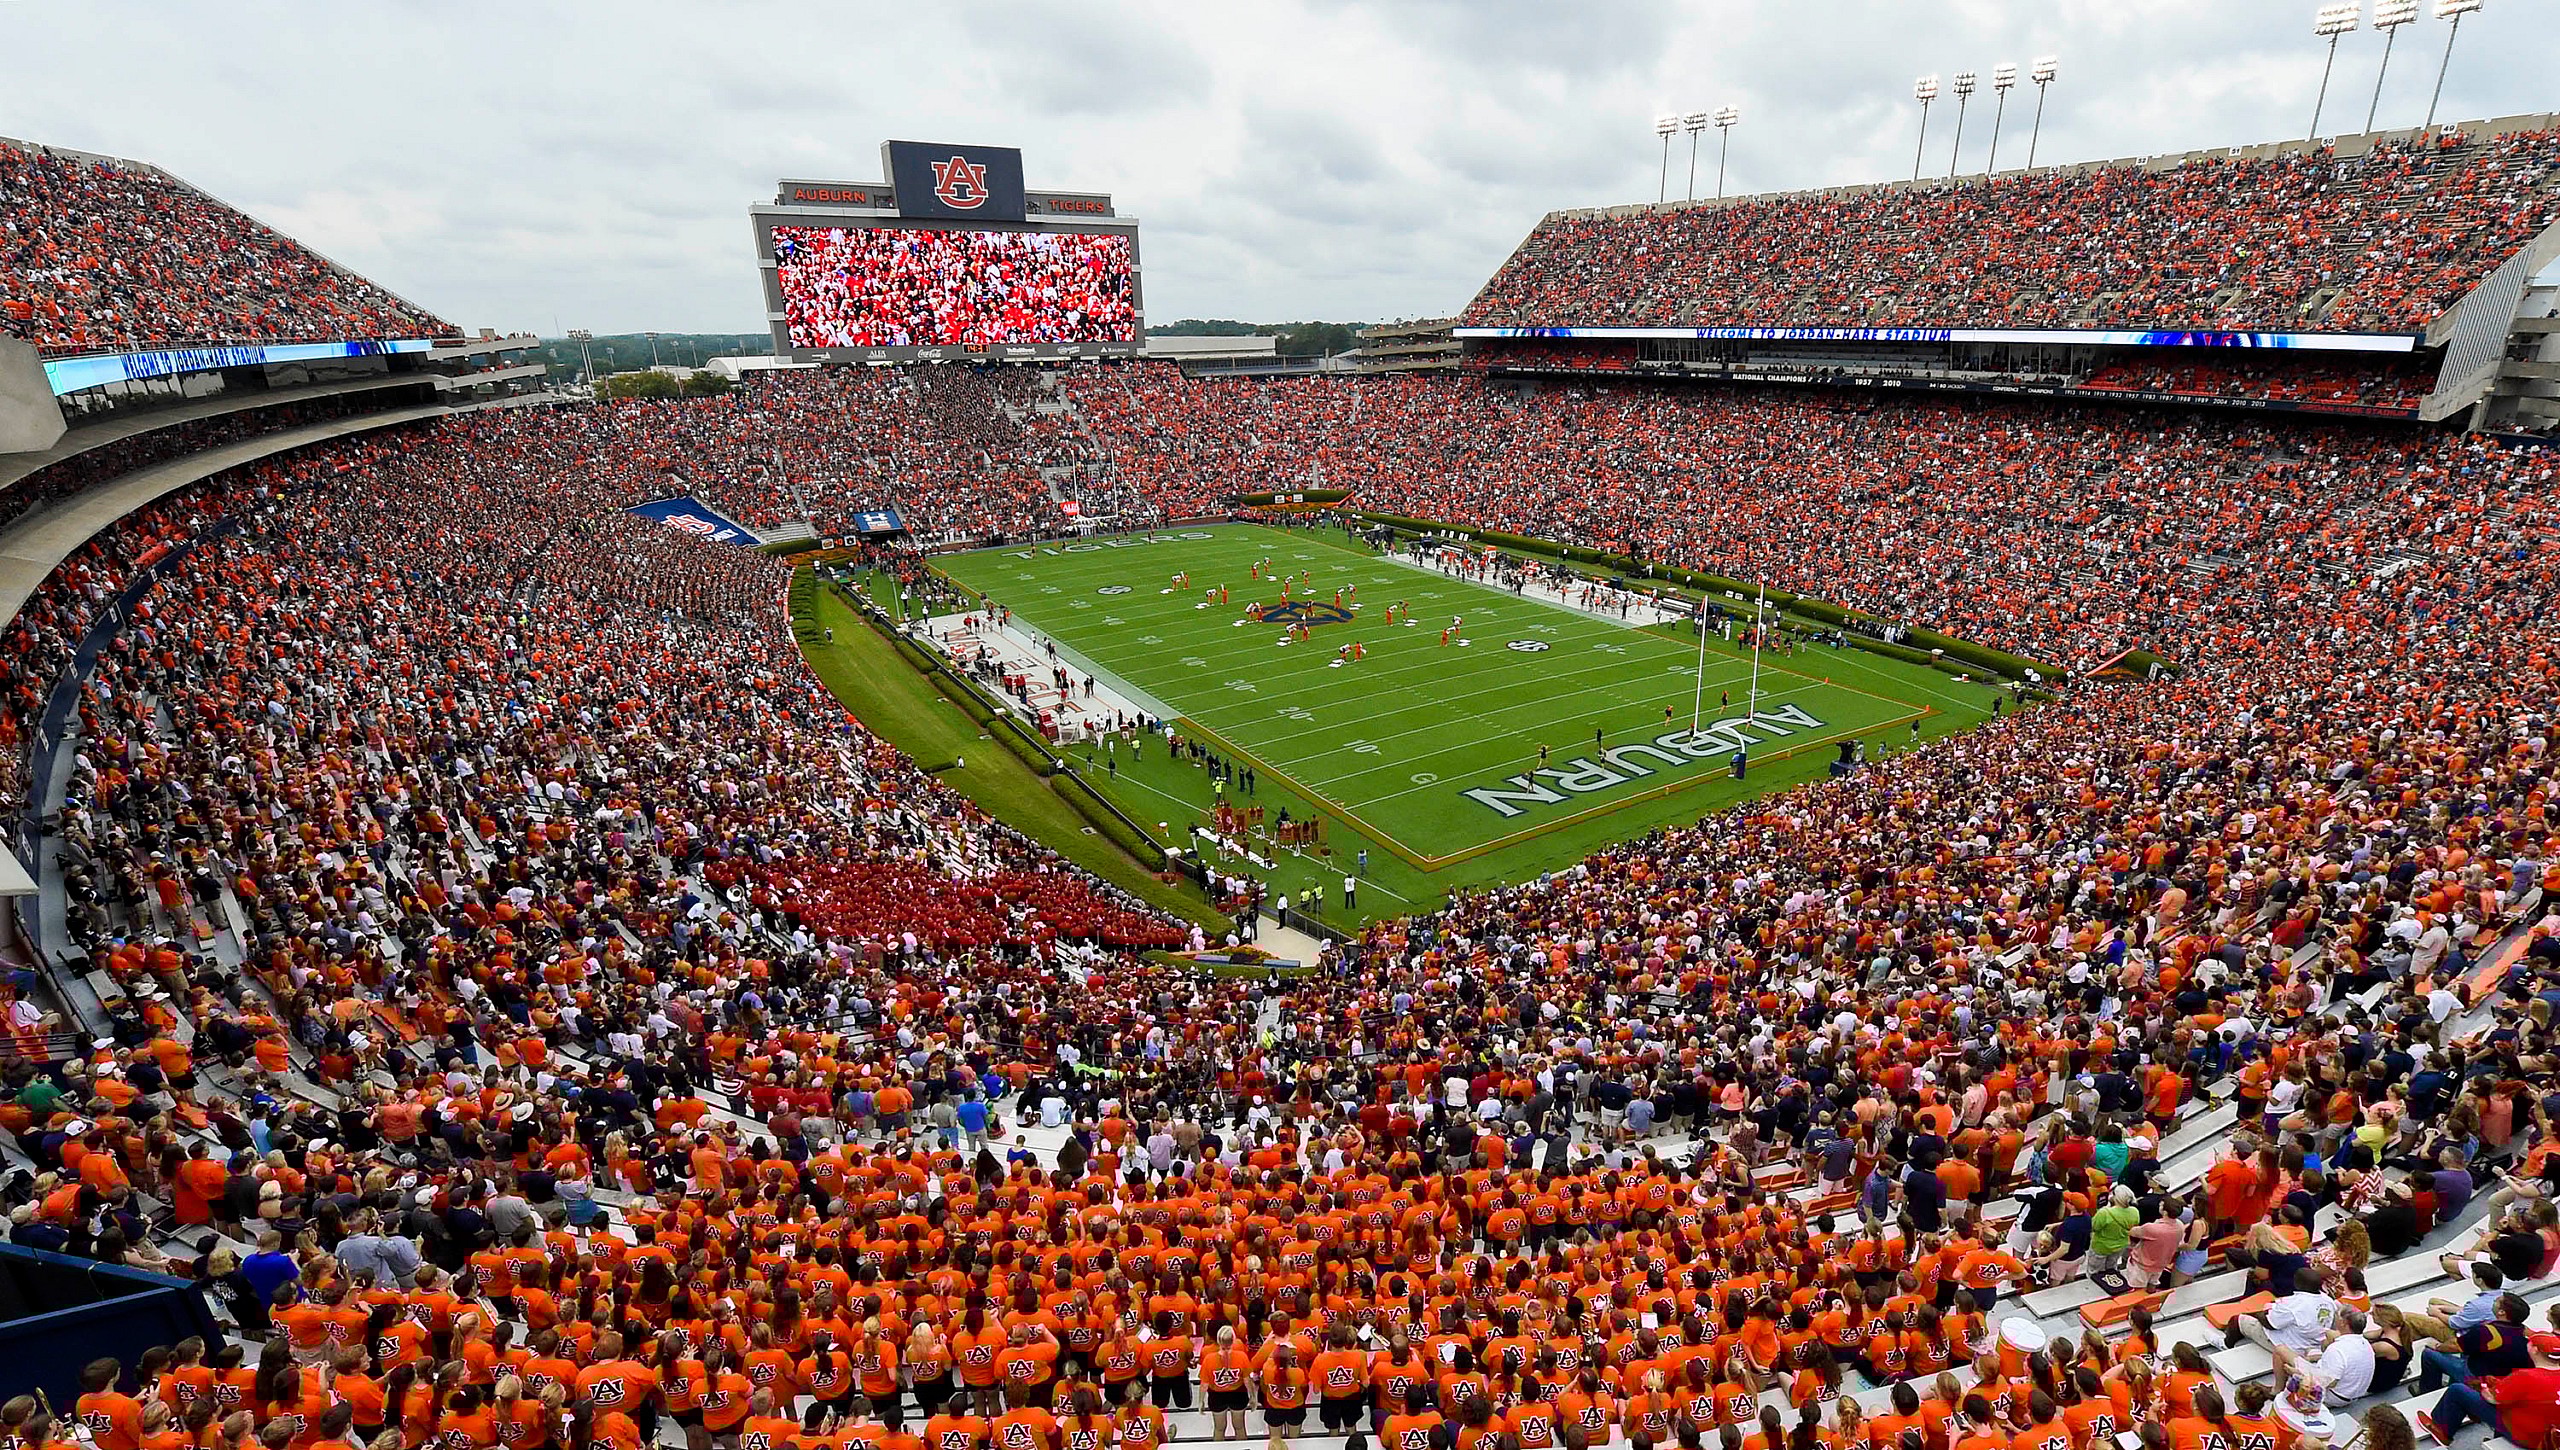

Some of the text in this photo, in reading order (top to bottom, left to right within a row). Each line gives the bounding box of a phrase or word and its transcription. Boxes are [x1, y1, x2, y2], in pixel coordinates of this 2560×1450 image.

[795, 188, 866, 203] AUBURN
[1049, 199, 1105, 213] TIGERS
[1696, 328, 1951, 341] WELCOME TO JORDAN-HARE STADIUM
[120, 352, 163, 379] WELCOME
[232, 346, 267, 366] STADIUM
[1732, 373, 1764, 381] NATIONAL
[1767, 375, 1807, 383] CHAMPIONS
[1855, 378, 1872, 386] 1957
[1001, 532, 1215, 559] TIGERS
[1276, 706, 1315, 722] 20
[1343, 739, 1382, 756] 10
[1461, 704, 1828, 818] AUBURN
[1410, 772, 1438, 785] G
[653, 1164, 669, 1179] 14
[271, 1320, 293, 1340] AU
[323, 1321, 348, 1340] AU
[377, 1336, 400, 1359] AU
[966, 1345, 992, 1366] AU
[1154, 1348, 1180, 1367] AU
[1008, 1359, 1035, 1379] AU
[1556, 1347, 1579, 1371] AU
[527, 1372, 554, 1391] AU
[749, 1363, 778, 1384] AU
[1327, 1365, 1354, 1387] AU
[213, 1383, 242, 1403] AU
[589, 1379, 624, 1407] AU
[660, 1376, 689, 1397] AU
[1388, 1375, 1413, 1397] AU
[1451, 1380, 1478, 1404] AU
[1540, 1382, 1565, 1401] AU
[1690, 1395, 1714, 1420] AU
[1731, 1393, 1755, 1419] AU
[81, 1410, 113, 1434] AU
[1124, 1415, 1150, 1443] AU
[1522, 1415, 1549, 1442] AU
[1579, 1407, 1606, 1431] AU
[2089, 1414, 2116, 1439] AU
[444, 1428, 471, 1449] AU
